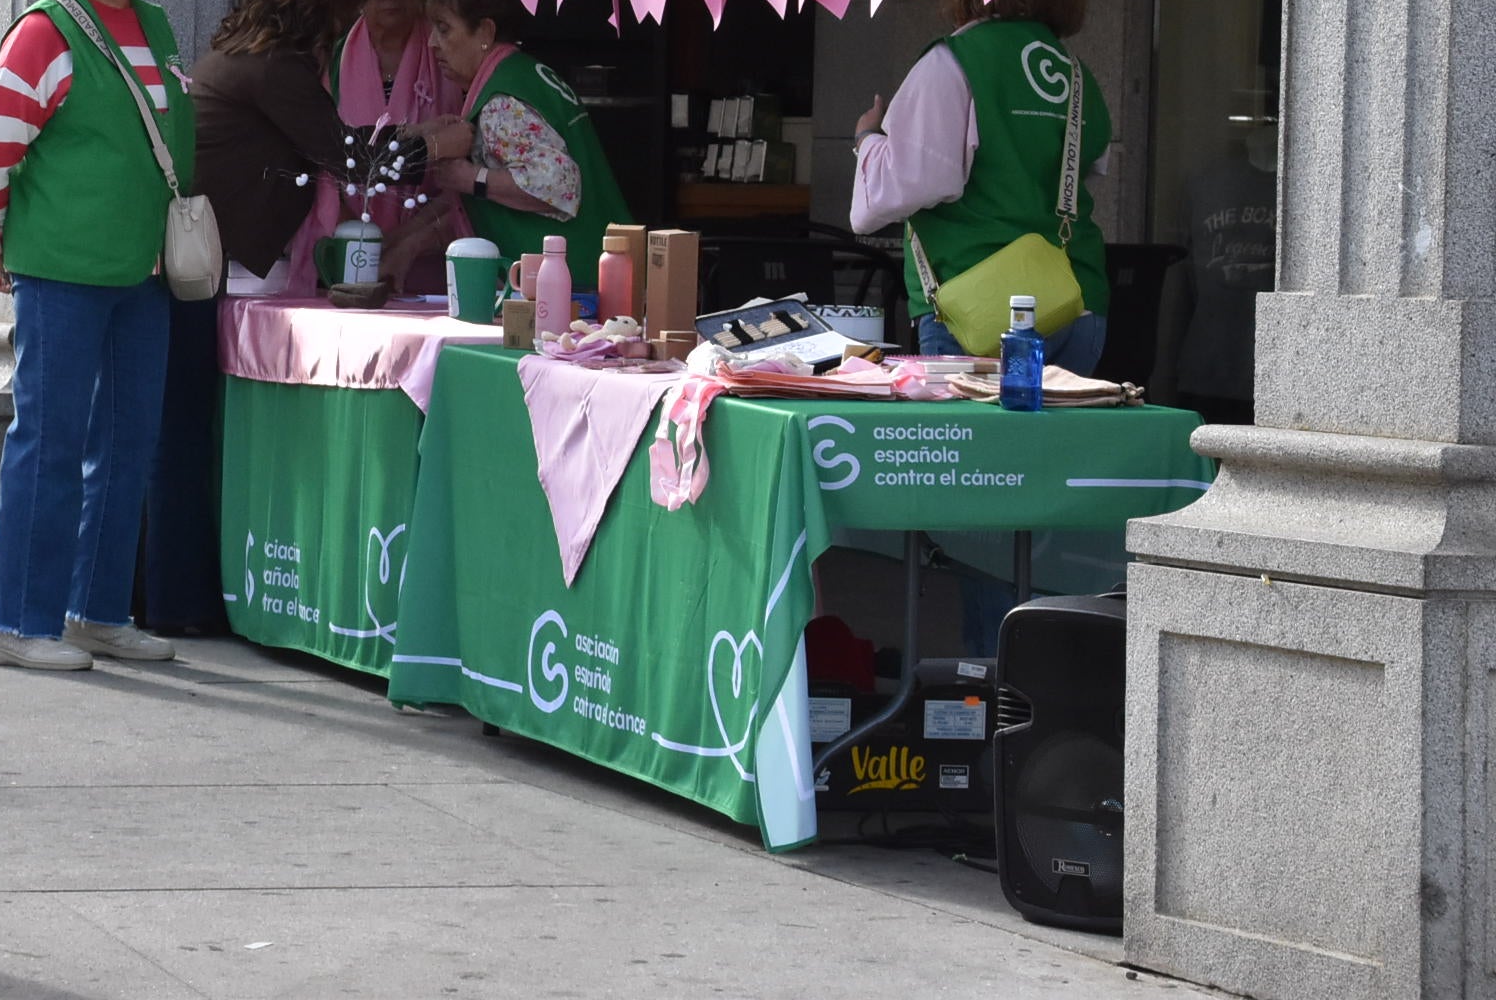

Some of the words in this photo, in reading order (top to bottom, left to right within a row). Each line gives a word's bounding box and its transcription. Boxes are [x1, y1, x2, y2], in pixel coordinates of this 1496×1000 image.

[1066, 142, 1077, 171] LOLA
[1203, 207, 1237, 233] THE
[873, 423, 973, 442] asociación
[874, 447, 960, 467] española
[875, 470, 935, 486] contra
[940, 469, 956, 486] el
[961, 469, 1025, 487] cáncer
[286, 596, 298, 616] el
[608, 706, 647, 736] cánce
[851, 745, 927, 782] Valle
